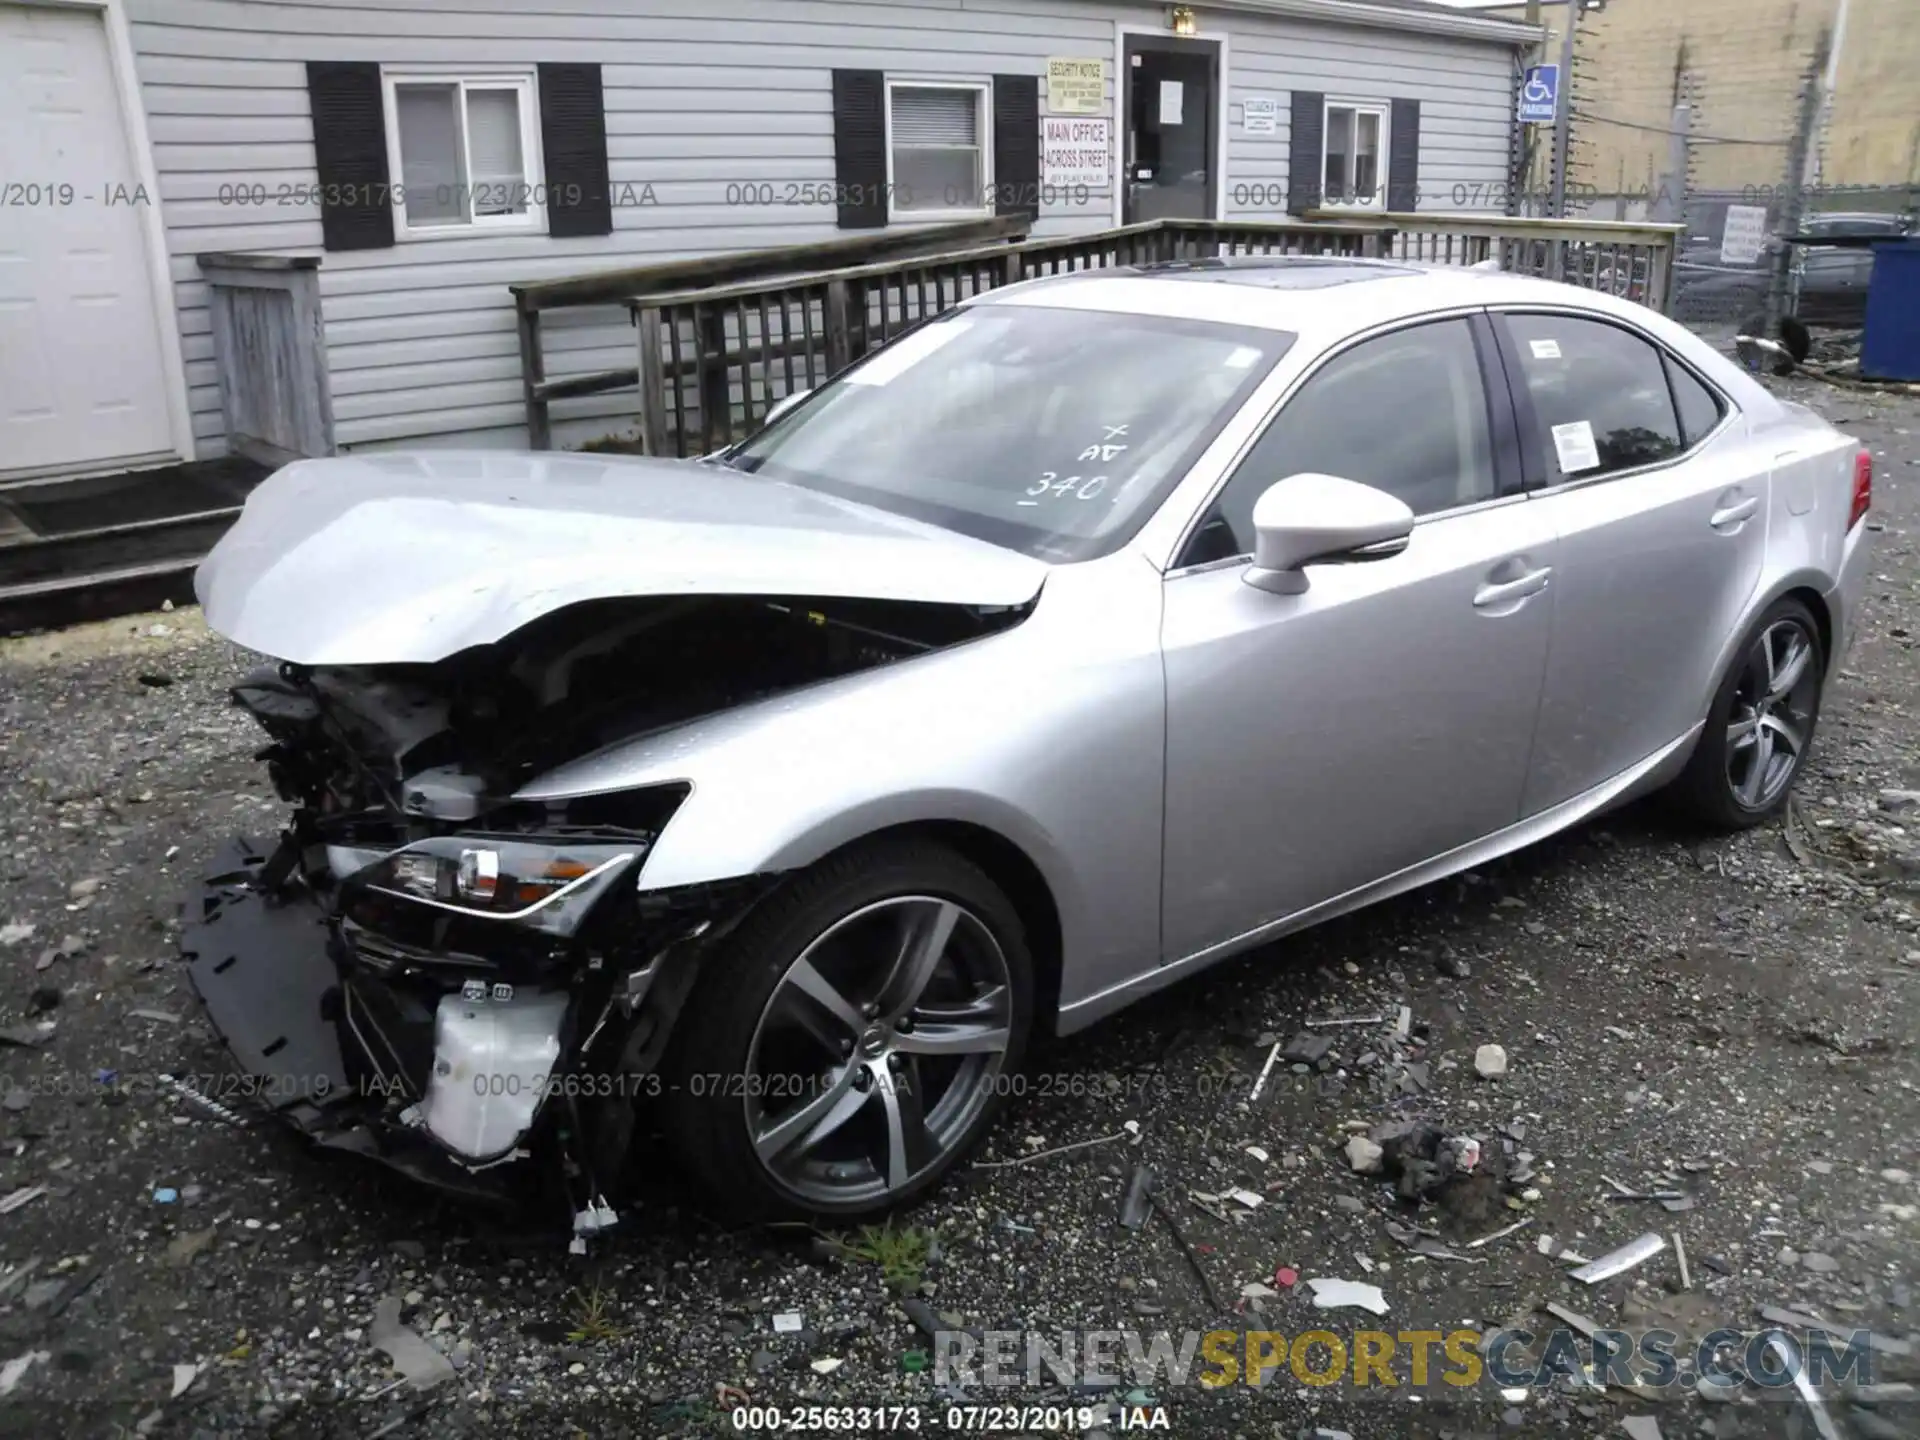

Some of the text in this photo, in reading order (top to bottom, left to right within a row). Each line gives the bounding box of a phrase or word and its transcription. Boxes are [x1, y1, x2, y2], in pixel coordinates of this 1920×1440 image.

[1050, 61, 1101, 78] SECURITY NOTICE
[1047, 123, 1105, 142] MAIN OFFICE
[1046, 149, 1107, 168] ACROSS STREET
[1025, 471, 1109, 500] 340
